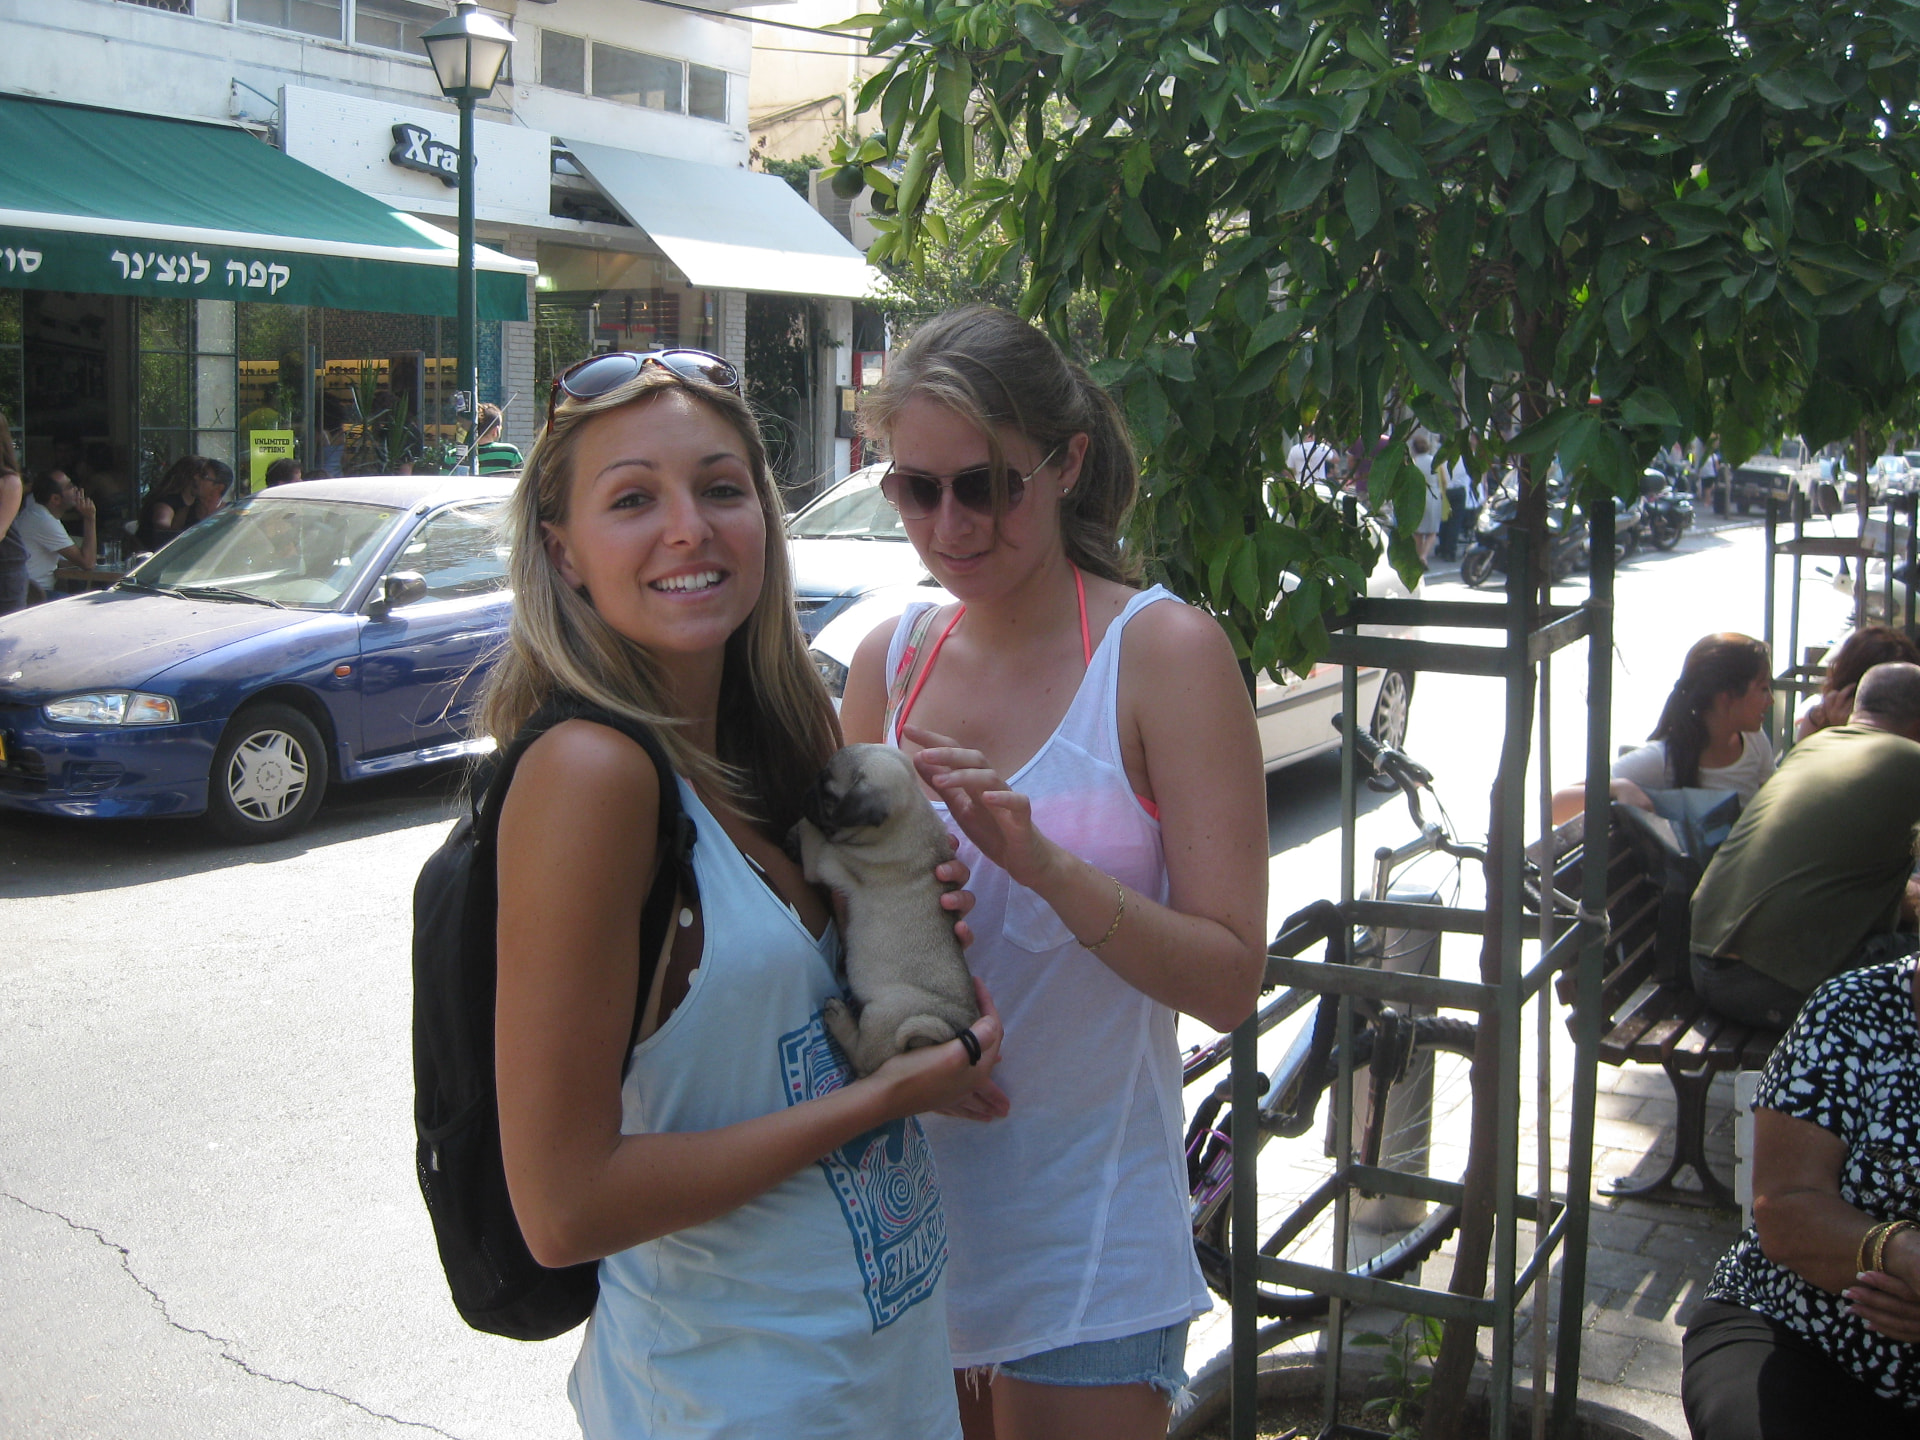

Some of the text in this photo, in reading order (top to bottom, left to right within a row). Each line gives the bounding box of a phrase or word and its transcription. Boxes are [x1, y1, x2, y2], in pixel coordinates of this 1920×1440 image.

[405, 128, 460, 174] Xra
[226, 259, 290, 296] קפה
[254, 438, 290, 446] UNLIMITED
